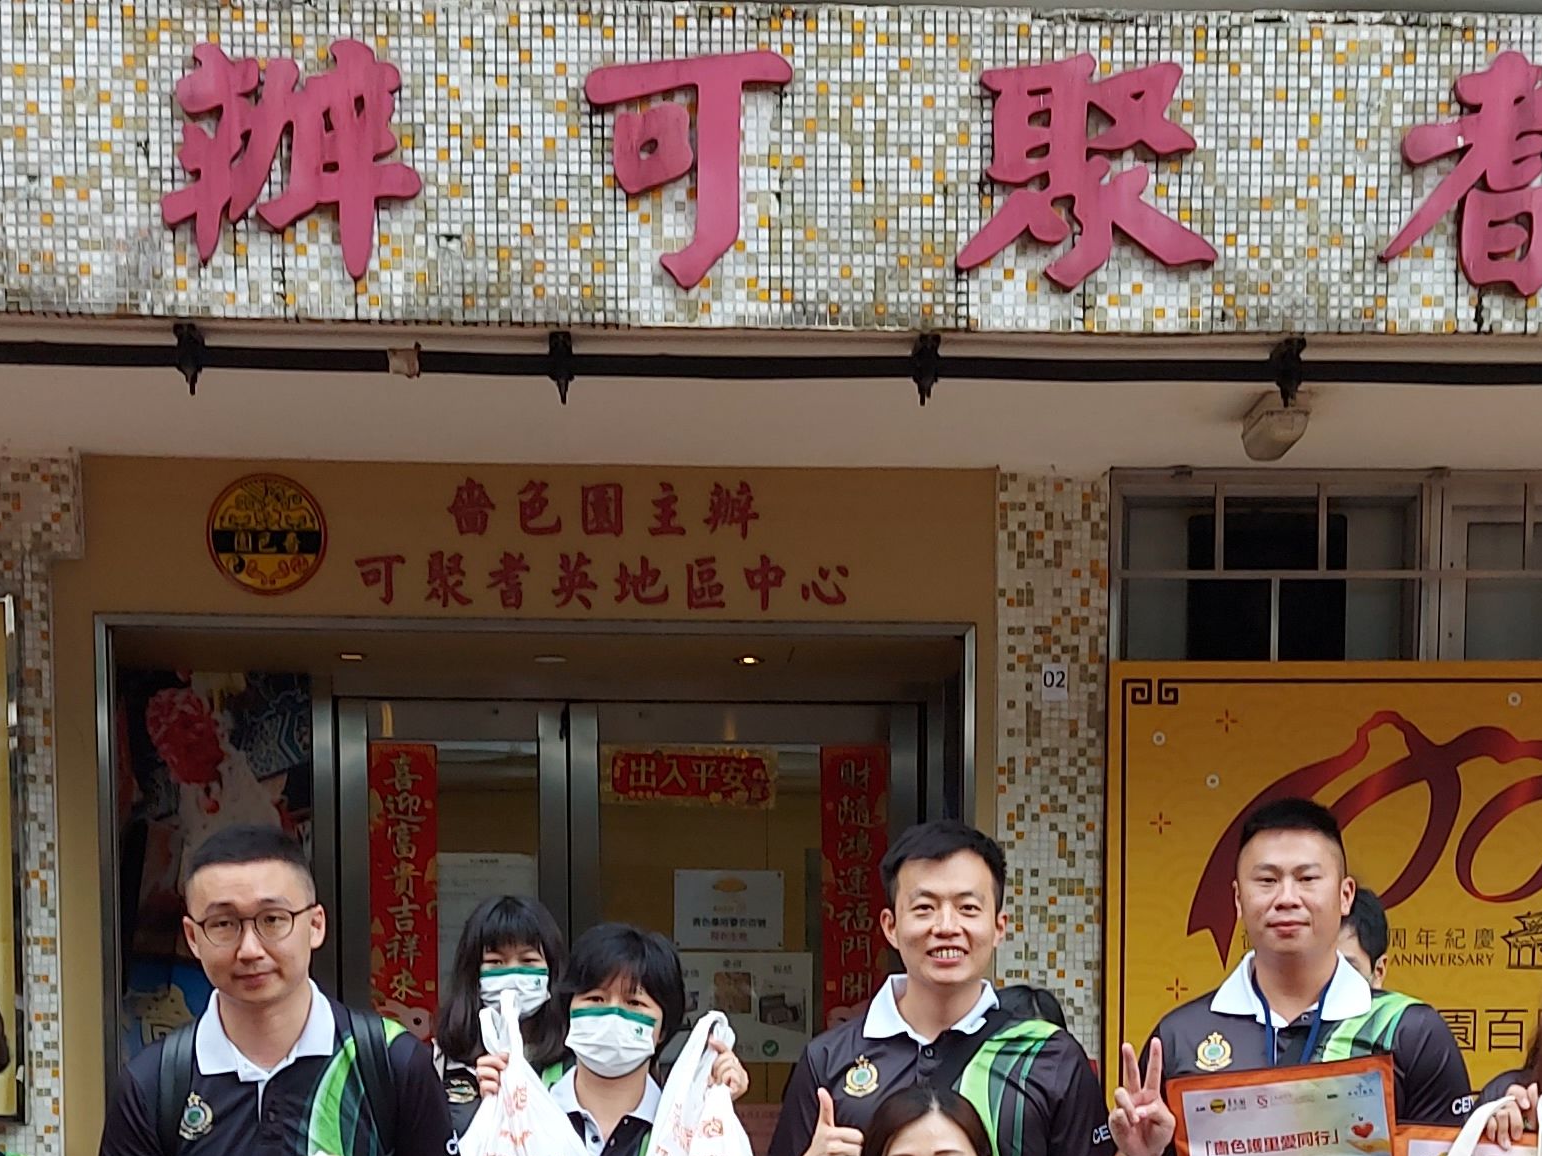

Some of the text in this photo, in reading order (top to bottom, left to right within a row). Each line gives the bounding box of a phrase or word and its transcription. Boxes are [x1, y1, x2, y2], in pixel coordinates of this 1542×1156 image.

[447, 476, 760, 540] 嗇色園主辦
[354, 550, 850, 610] 可聚耆英地區中心
[1043, 670, 1066, 688] 02
[629, 758, 747, 791] 出入平安
[1389, 952, 1495, 967] ANNIVERSARY
